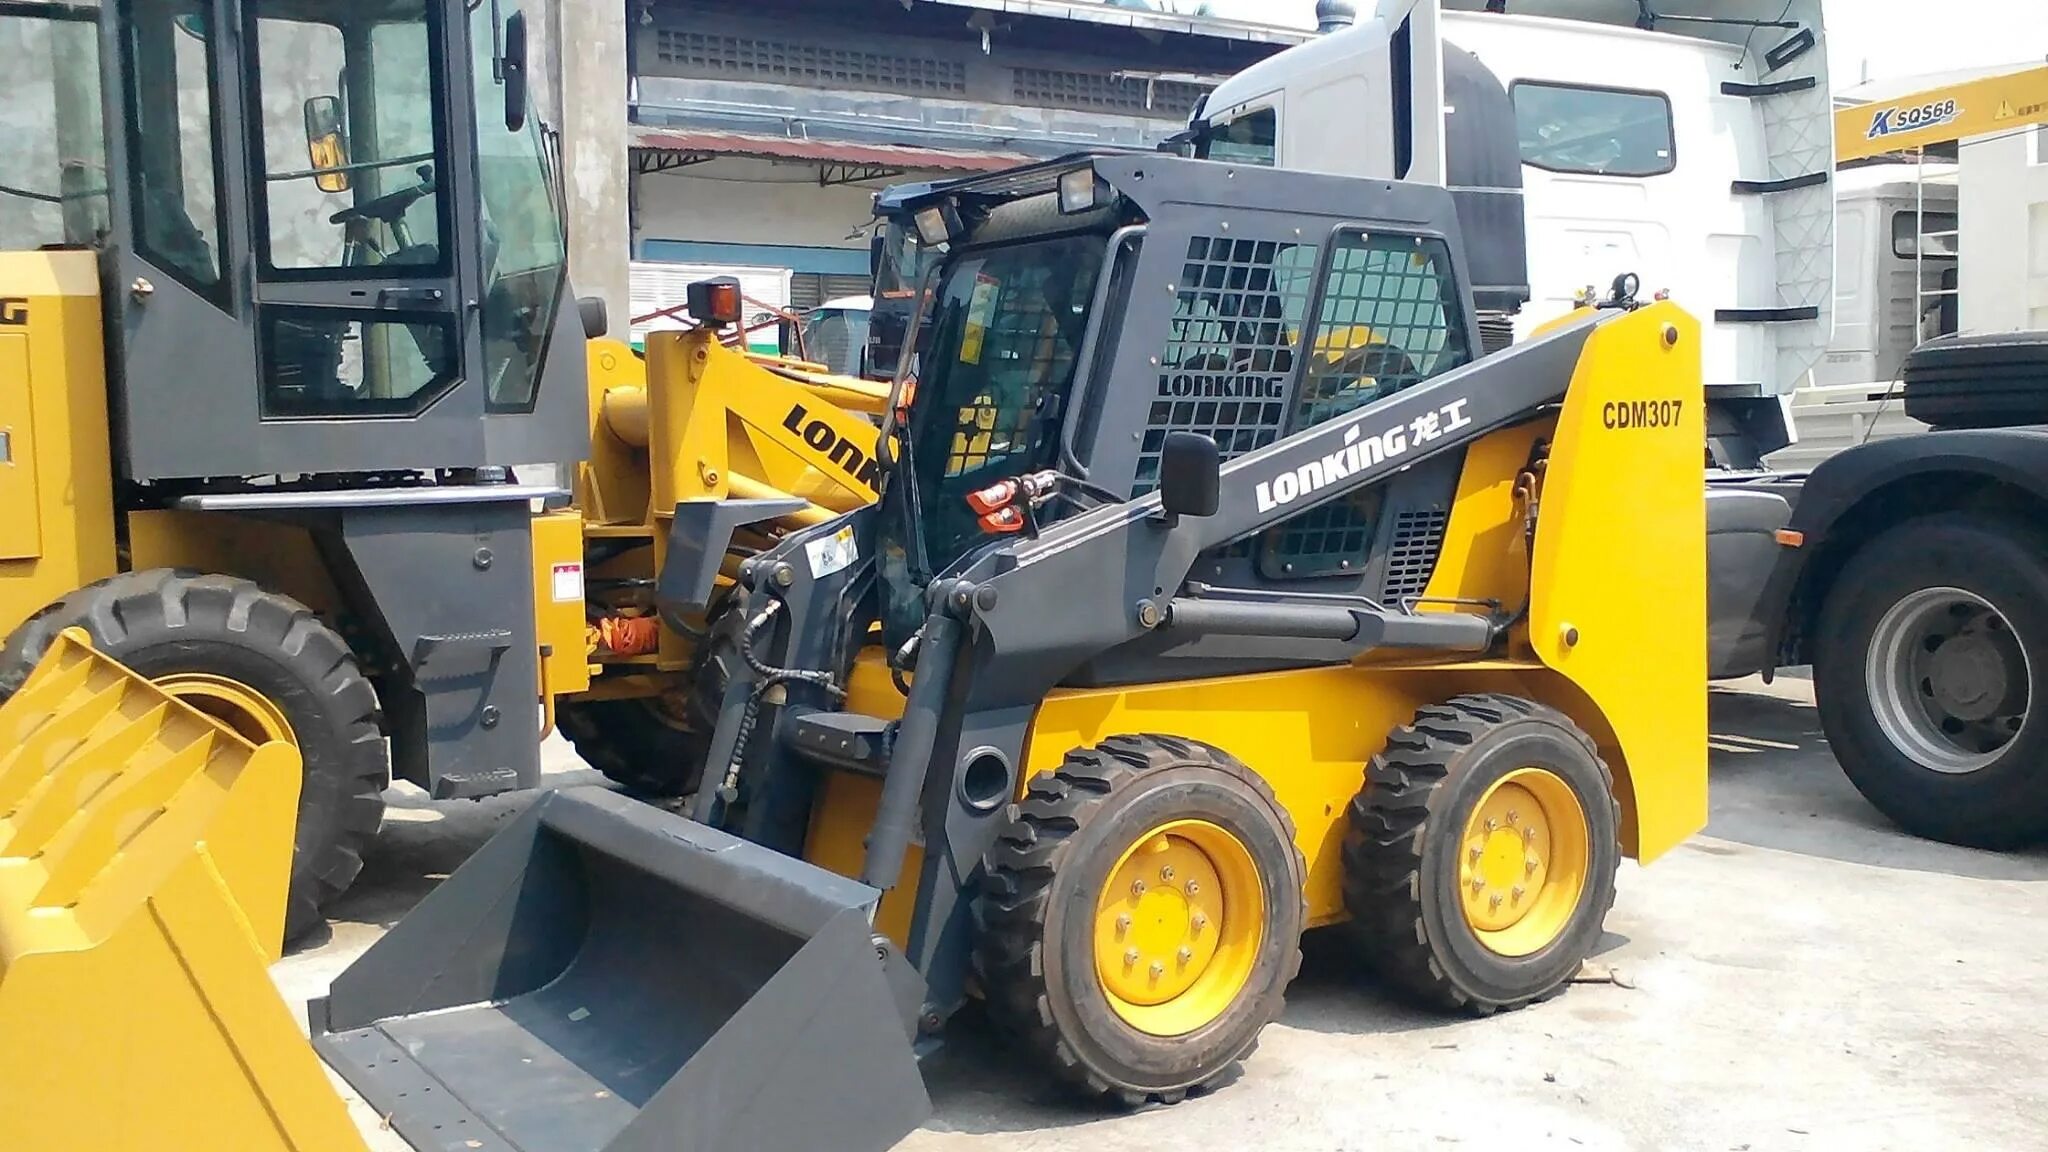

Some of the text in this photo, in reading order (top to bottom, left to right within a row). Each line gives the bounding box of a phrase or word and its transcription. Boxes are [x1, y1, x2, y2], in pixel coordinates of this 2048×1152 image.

[1896, 99, 1955, 127] SQS68
[1158, 374, 1283, 397] LONKING
[1603, 400, 1682, 429] CDM307
[1255, 397, 1472, 513] LONKING 龙工
